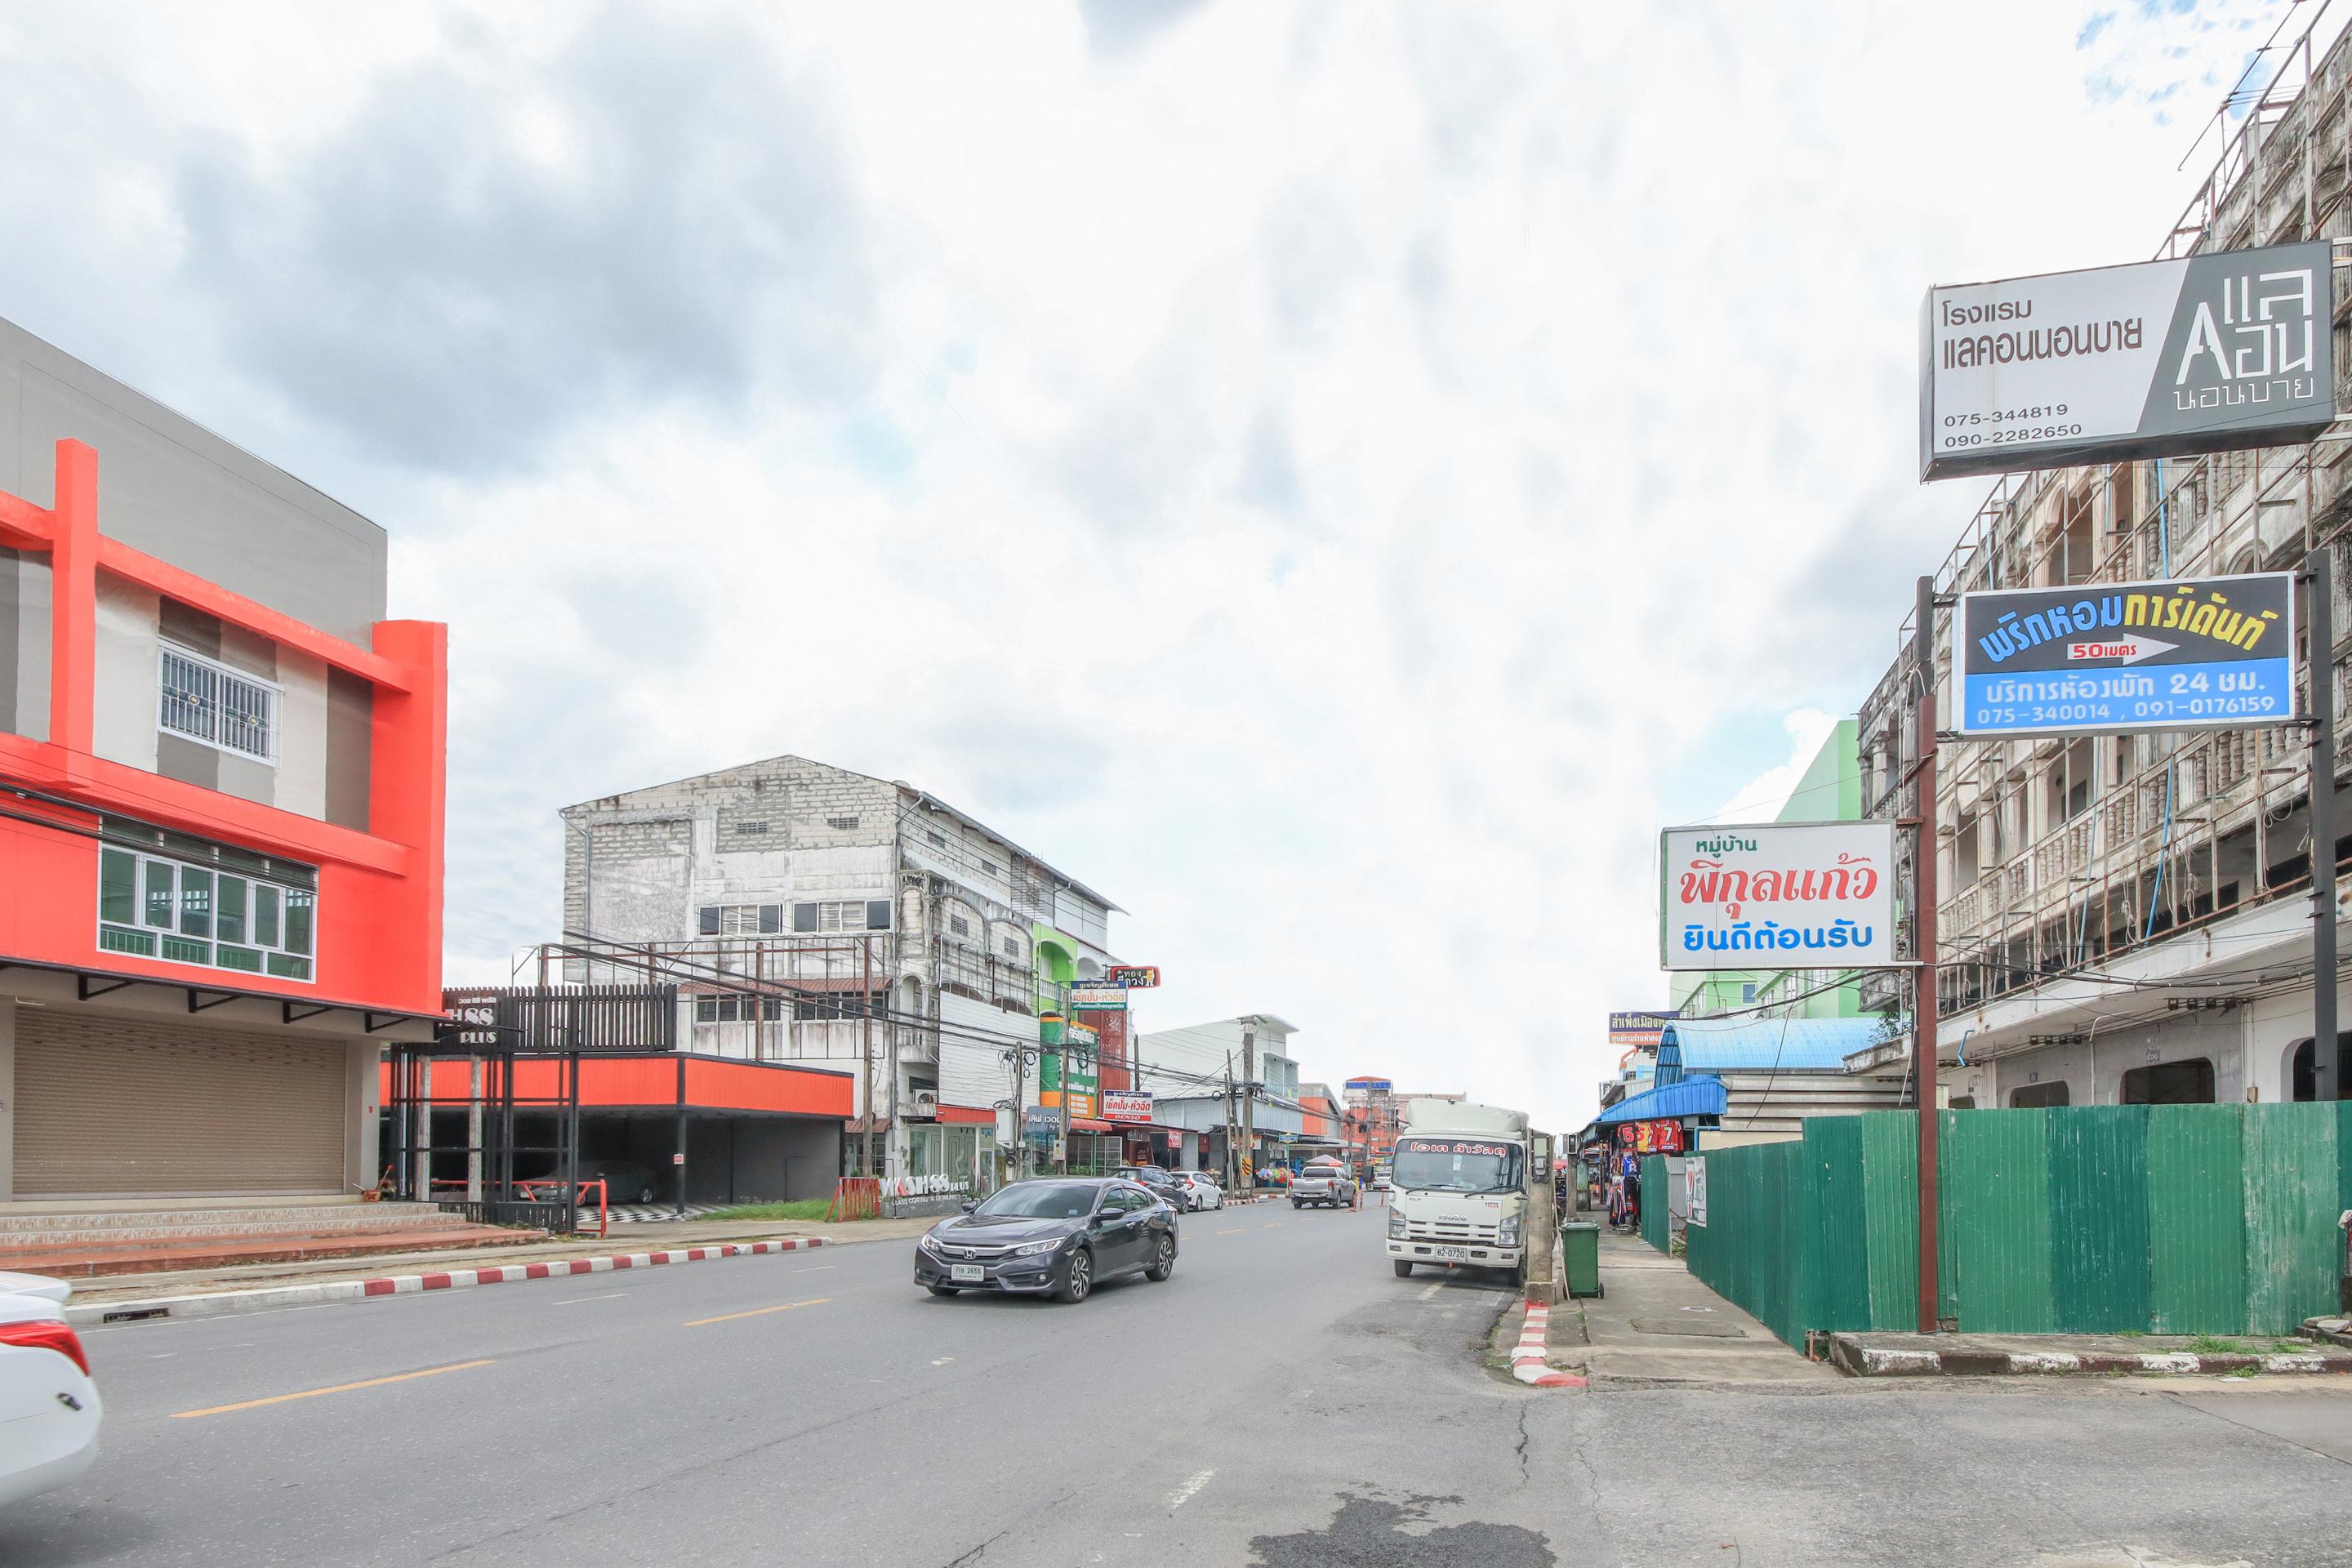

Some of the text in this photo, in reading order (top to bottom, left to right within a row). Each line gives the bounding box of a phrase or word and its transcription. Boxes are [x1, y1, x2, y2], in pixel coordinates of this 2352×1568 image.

[1941, 299, 2033, 327] โรงแรม
[1943, 316, 2143, 370] แลคอนนอนบาย
[2173, 376, 2314, 411] นอนบาย
[1944, 403, 2069, 428] 075-344819
[1944, 423, 2082, 448] 090-2282650
[1985, 670, 2266, 704] บริการห้องพัก 24 ชม.
[1977, 695, 2276, 724] 075-340014 091-0176159
[1695, 835, 1758, 858] หมู่บ้าน
[1680, 853, 1878, 920] พิกุลแก้ว
[1683, 918, 1873, 951] ยินดีต้อนรับ
[460, 1031, 497, 1044] PLUS
[1664, 1126, 1673, 1142] 7
[1410, 1141, 1507, 1158] โอเค ค้าวัสดุ
[878, 1175, 929, 1197] WASH
[929, 1174, 950, 1192] 88
[1437, 1249, 1465, 1258] 82-0720
